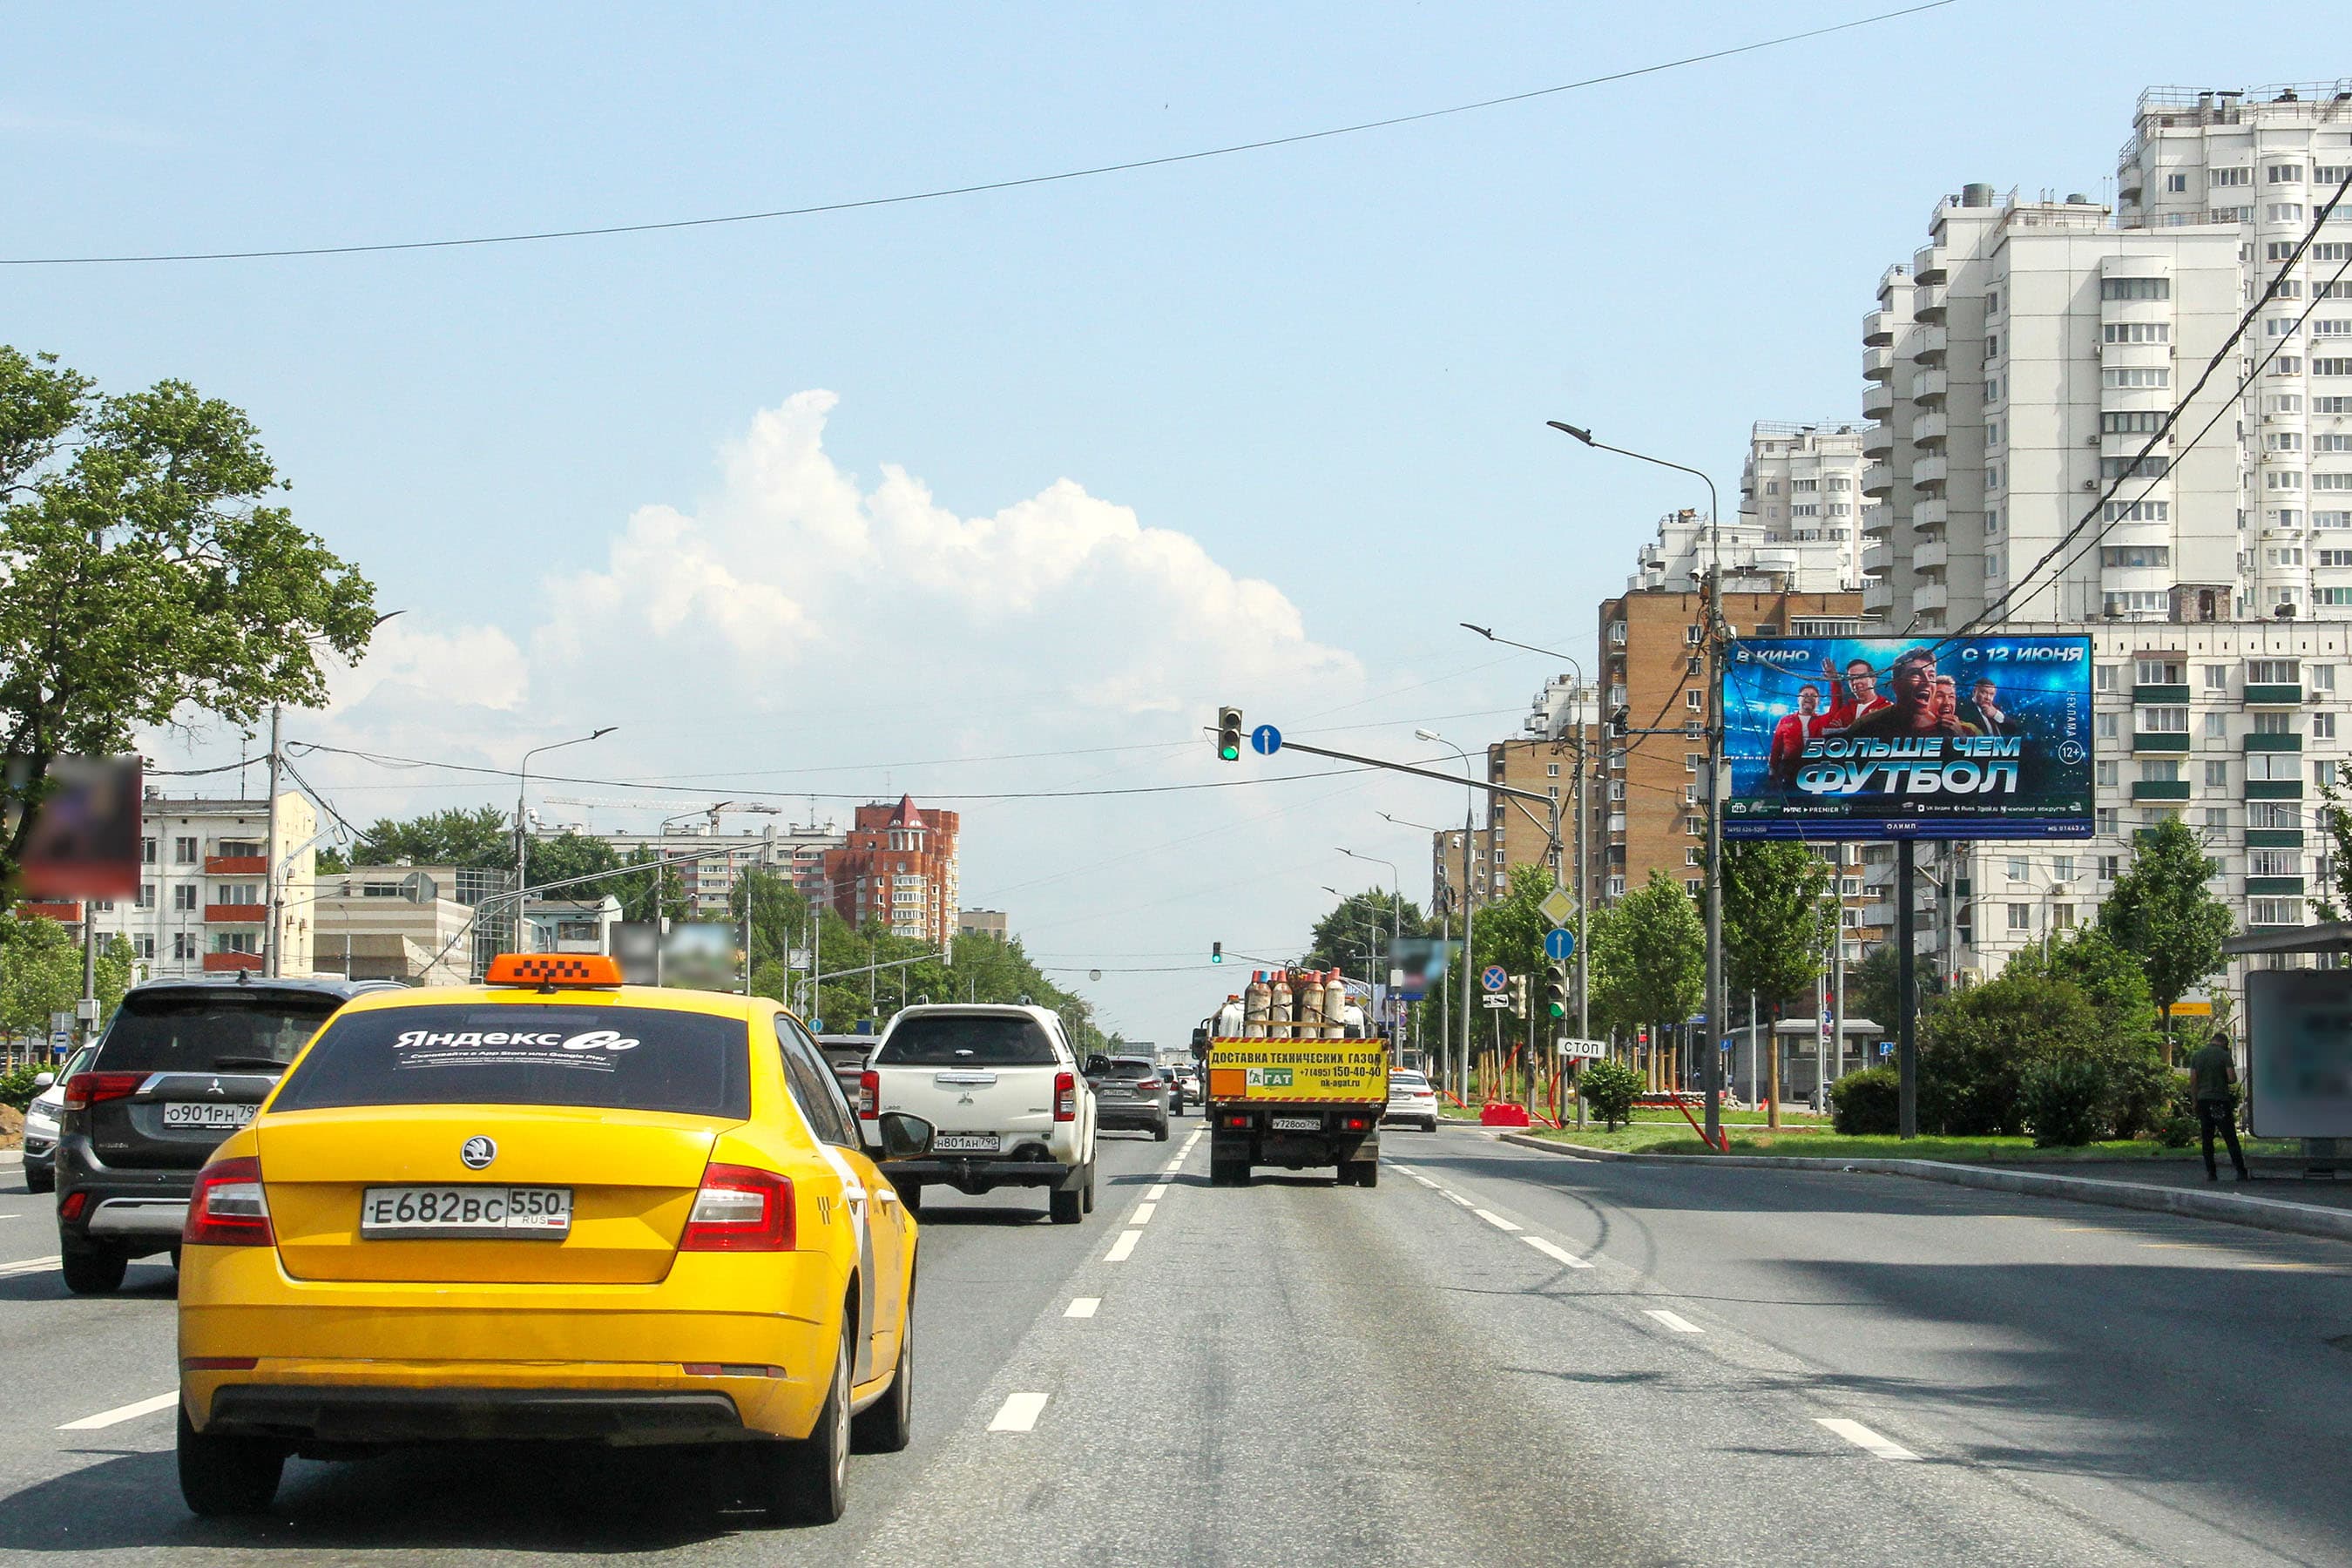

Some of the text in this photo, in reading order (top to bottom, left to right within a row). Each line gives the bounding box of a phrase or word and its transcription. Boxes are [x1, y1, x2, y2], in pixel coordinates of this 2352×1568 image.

[1736, 650, 1809, 662] В КИНО
[1962, 647, 2084, 662] С 12 ИЮНЯ
[2066, 690, 2077, 737] РЕКЛАМА
[1801, 737, 2022, 758] БОЛЬШЕ ЧЕМ
[2062, 747, 2080, 758] 12+
[1796, 760, 2019, 794] ФУТБОЛ
[393, 1031, 640, 1051] Яндекс Go
[1565, 1041, 1598, 1055] СТОП
[1212, 1052, 1381, 1064] ДОСТАВКА ТЕХНИЧЕСКИХ ГАЗОВ
[1301, 1065, 1381, 1077] +7 (495) 150-40-40
[1321, 1079, 1360, 1088] nk-agat.ru
[980, 1137, 997, 1146] 790
[375, 1191, 560, 1223] Е682ВС 550
[523, 1215, 546, 1225] RUS
